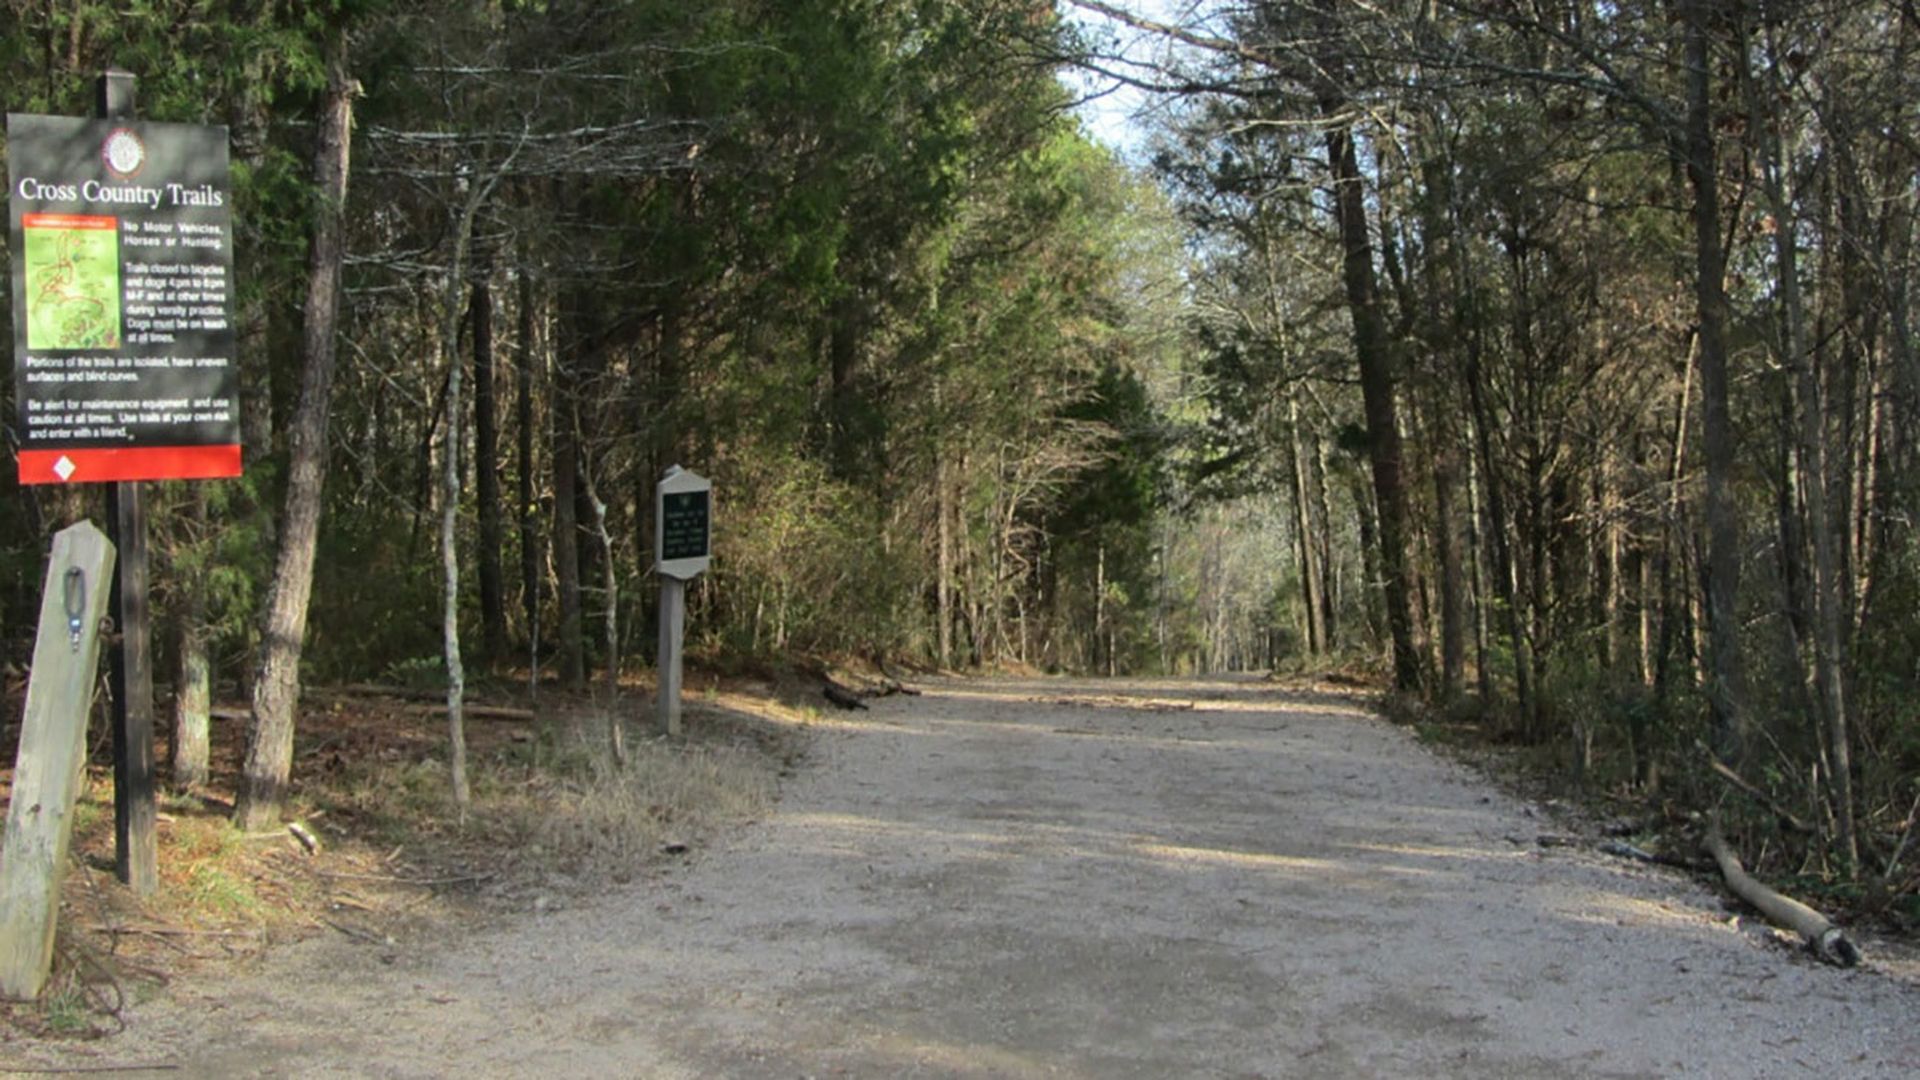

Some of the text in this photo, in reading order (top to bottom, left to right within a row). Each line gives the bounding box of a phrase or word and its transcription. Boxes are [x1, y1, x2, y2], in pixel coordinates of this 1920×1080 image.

[20, 177, 223, 209] Cross Country Trails
[124, 221, 139, 231] No
[144, 223, 173, 233] Motor
[125, 236, 160, 246] Horses
[166, 238, 176, 246] or
[125, 263, 225, 275] Trails closed to bicycles
[126, 277, 143, 288] and
[145, 277, 166, 289] dogs
[192, 278, 202, 288] to
[147, 292, 164, 301] and
[166, 292, 175, 301] at
[177, 292, 200, 302] other
[203, 292, 225, 302] times
[127, 305, 155, 316] during
[127, 318, 151, 330] Dogs
[153, 320, 175, 329] must
[176, 319, 188, 329] be
[190, 320, 201, 329] on
[127, 332, 136, 342] at
[27, 357, 64, 367] Portions
[66, 358, 75, 367] of
[77, 358, 92, 367] the
[94, 357, 114, 367] trails
[117, 359, 131, 367] are
[172, 358, 193, 367] have
[196, 359, 228, 367] uneven
[27, 372, 64, 382] surfaces
[67, 372, 84, 381] and
[86, 372, 107, 381] blind
[28, 398, 229, 411] Be alert for maintenance equipment and use
[29, 414, 62, 424] caution
[64, 414, 73, 424] at
[75, 414, 86, 424] all
[119, 413, 137, 423] Use
[139, 413, 160, 422] trails
[162, 413, 171, 422] at
[173, 413, 192, 424] your
[194, 413, 212, 422] own
[214, 412, 229, 421] risk
[29, 429, 47, 439] and
[49, 429, 71, 438] enter
[73, 428, 91, 438] with
[94, 429, 99, 437] a
